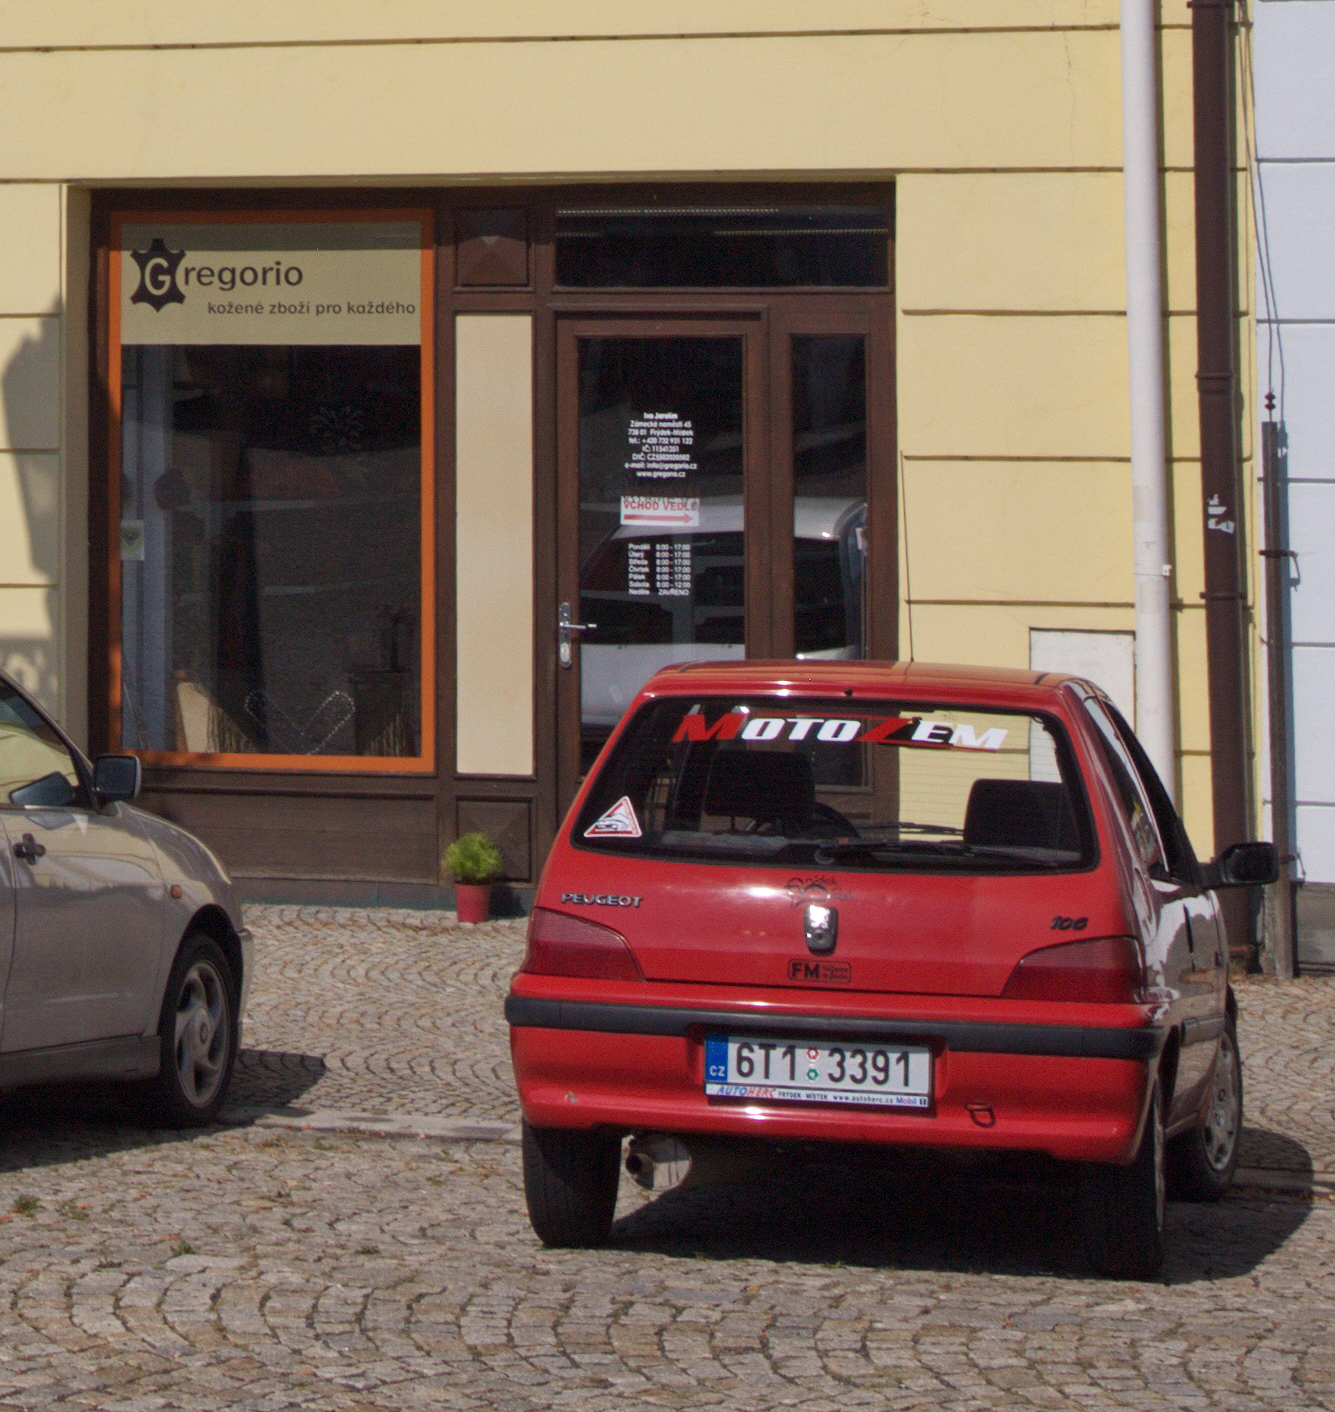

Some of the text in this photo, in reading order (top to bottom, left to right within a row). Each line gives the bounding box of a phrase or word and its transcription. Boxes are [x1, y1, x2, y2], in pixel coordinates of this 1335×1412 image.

[144, 257, 304, 296] Gregorio
[208, 300, 416, 317] kožené zboží pro každého
[623, 500, 660, 510] VCHOD
[561, 893, 644, 908] PEUGEOT
[1051, 916, 1089, 931] 106
[792, 962, 820, 979] FM
[709, 1064, 726, 1077] CZ
[735, 1042, 910, 1087] 6T1 3391
[717, 1086, 777, 1099] AUTOHERC
[833, 1094, 894, 1105] www.autoherc.cz
[896, 1097, 917, 1106] Mobil
